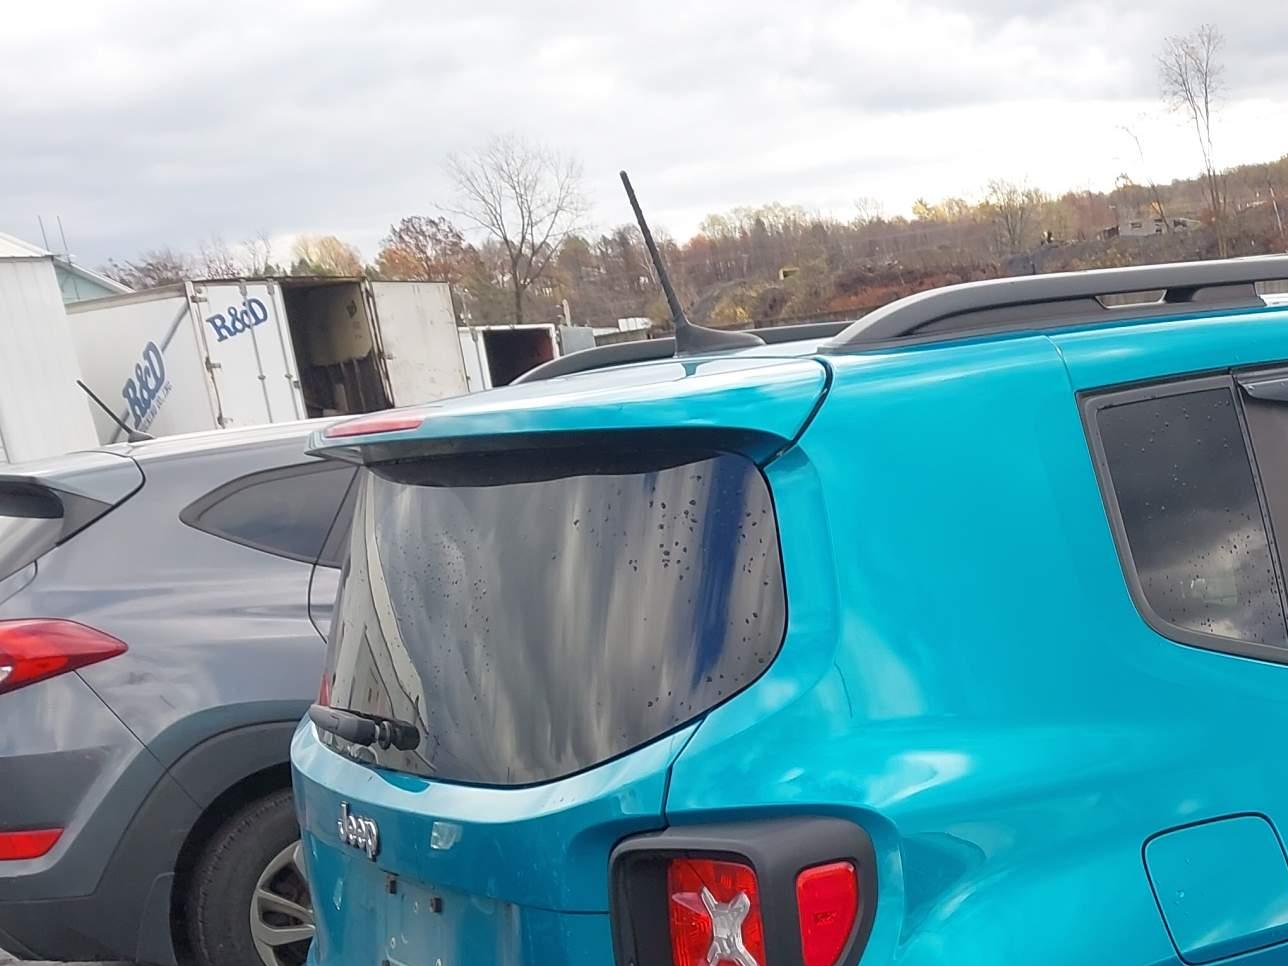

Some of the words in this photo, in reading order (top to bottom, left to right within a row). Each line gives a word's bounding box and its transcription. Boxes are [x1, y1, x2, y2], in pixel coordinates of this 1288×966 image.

[206, 298, 268, 342] R&D
[122, 341, 165, 431] R&D
[338, 801, 377, 860] Jeep
